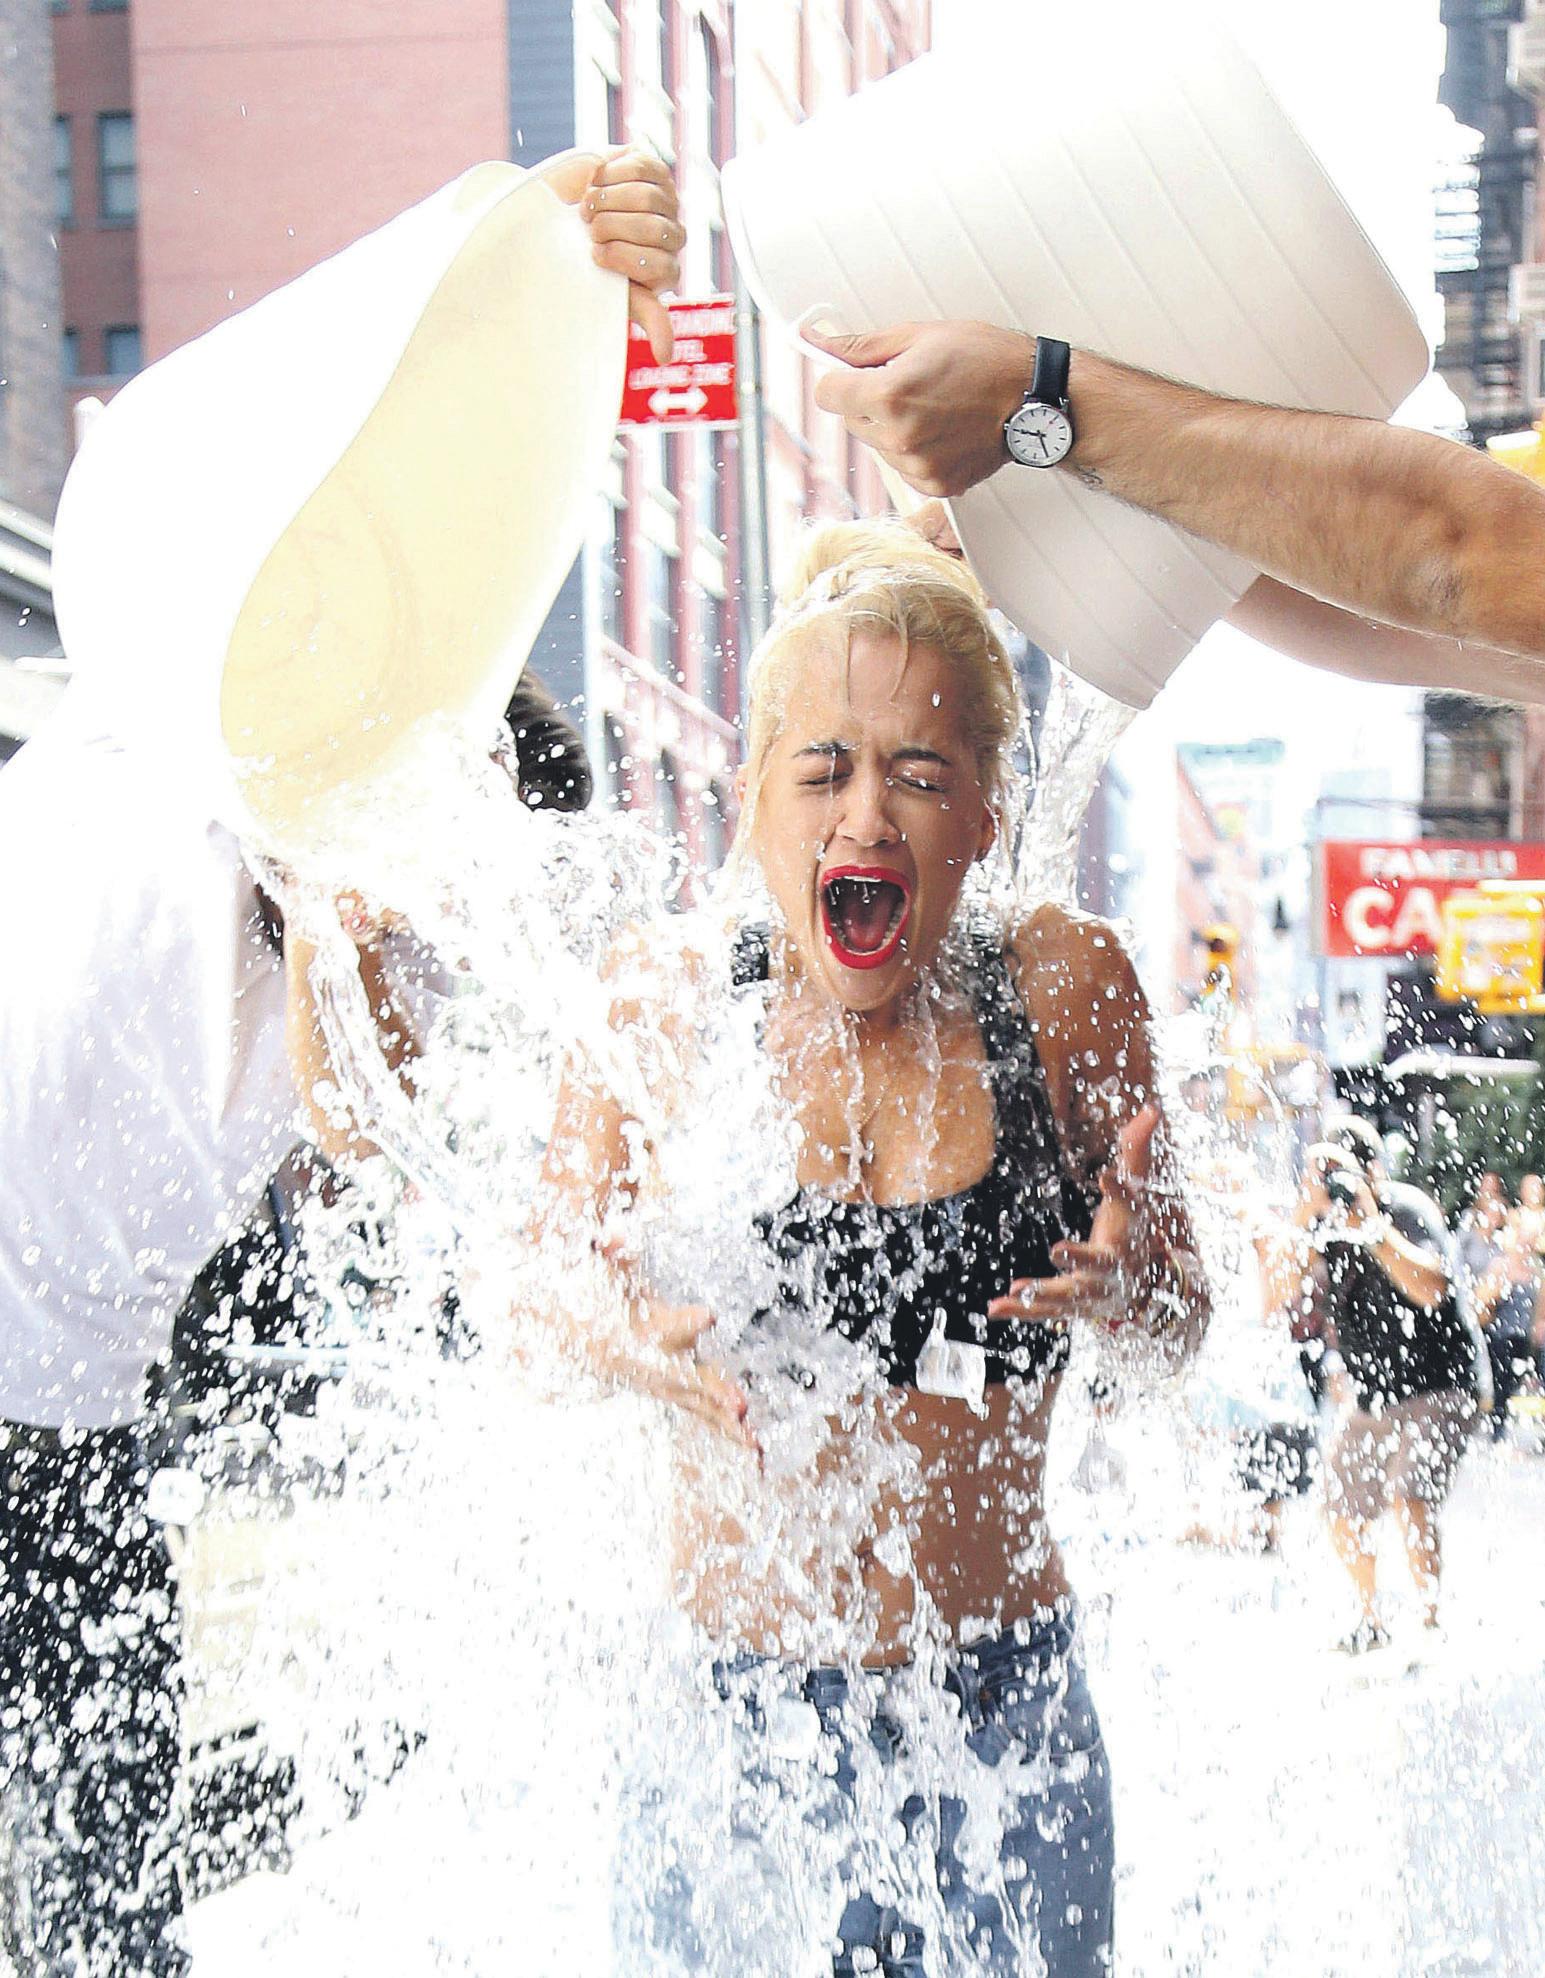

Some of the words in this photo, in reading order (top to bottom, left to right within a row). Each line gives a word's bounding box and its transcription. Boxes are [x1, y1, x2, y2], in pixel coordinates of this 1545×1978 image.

[670, 309, 737, 337] TANDING
[672, 339, 708, 362] TEL
[1359, 848, 1517, 878] FANELLI
[1342, 886, 1446, 948] CA
